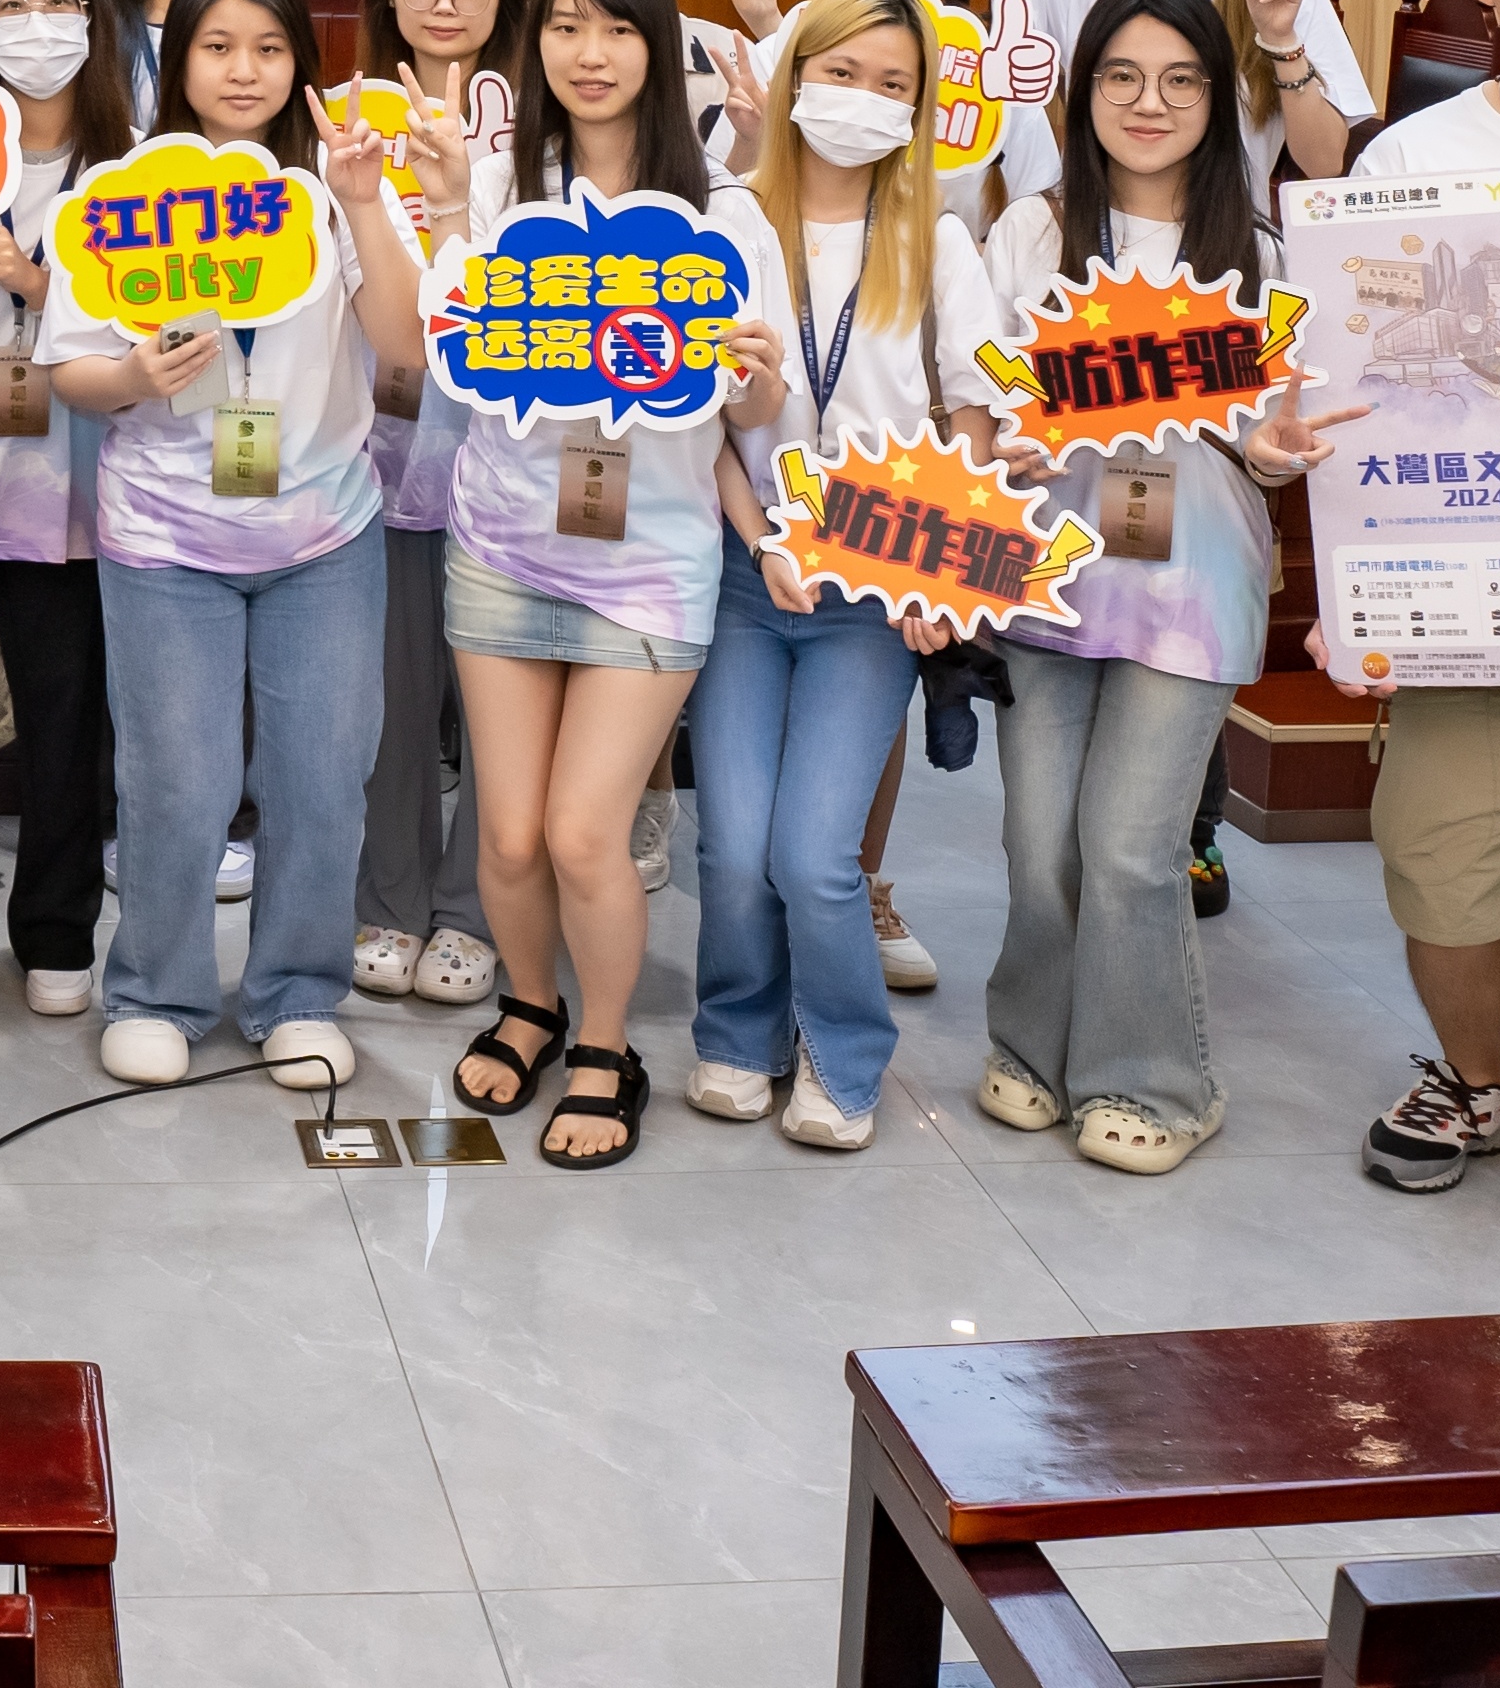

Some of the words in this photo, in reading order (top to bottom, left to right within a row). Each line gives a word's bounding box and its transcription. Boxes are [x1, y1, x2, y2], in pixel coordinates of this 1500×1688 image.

[82, 179, 292, 252] 江门好
[1343, 185, 1441, 208] 香港五邑總會
[119, 253, 263, 305] city
[463, 253, 727, 307] 珍爱生命
[464, 316, 746, 380] 远离毒品
[1031, 320, 1271, 417] 防诈骗
[812, 475, 1042, 606] 防诈骗
